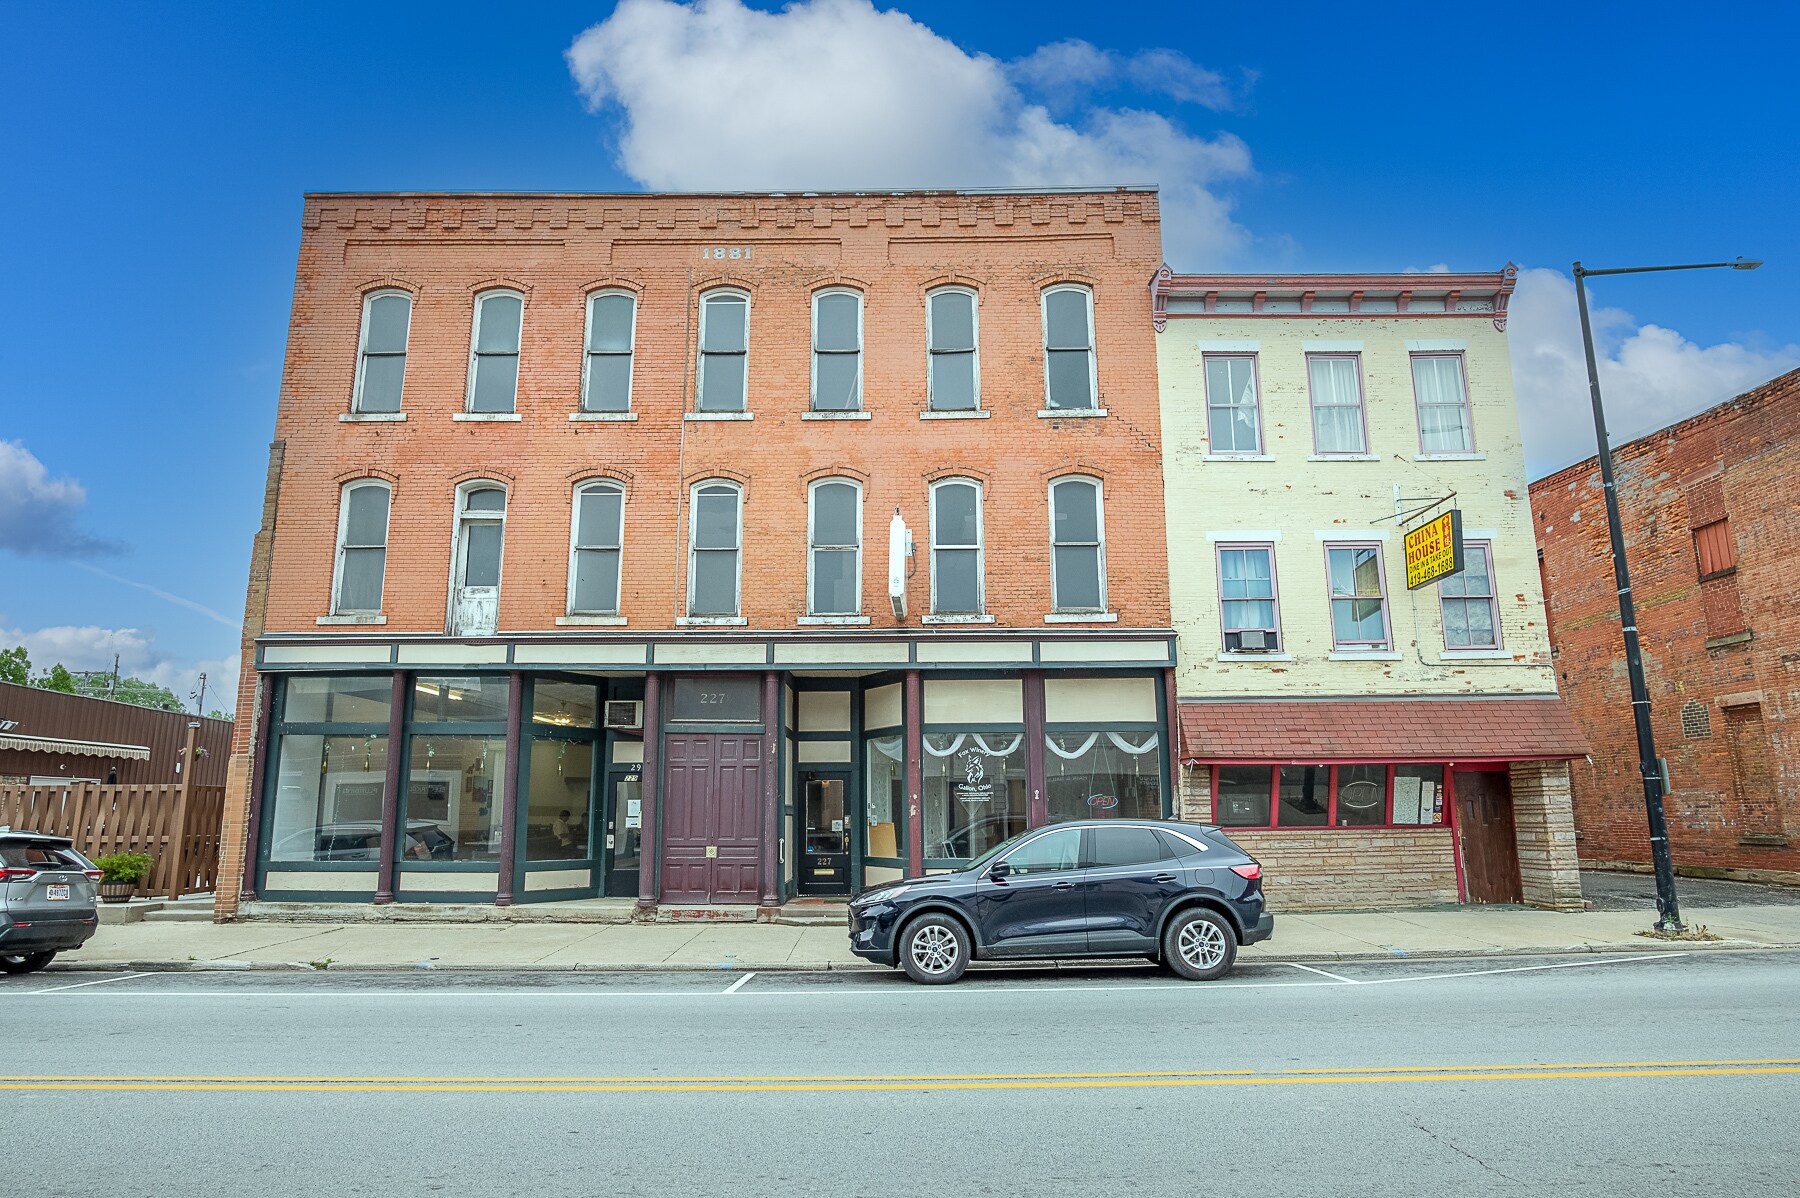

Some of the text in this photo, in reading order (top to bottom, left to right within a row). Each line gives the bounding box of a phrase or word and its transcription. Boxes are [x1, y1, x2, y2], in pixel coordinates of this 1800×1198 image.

[702, 247, 752, 260] 1881
[1408, 523, 1439, 549] CHINA
[1408, 537, 1441, 566] HOUSE
[1409, 562, 1420, 574] DINE
[1429, 551, 1442, 564] TAKE
[1441, 546, 1453, 558] OUT
[957, 749, 970, 758] Fox
[630, 763, 642, 772] 29
[977, 783, 992, 791] Ohio
[1089, 796, 1116, 806] OPEN
[817, 857, 832, 866] 227
